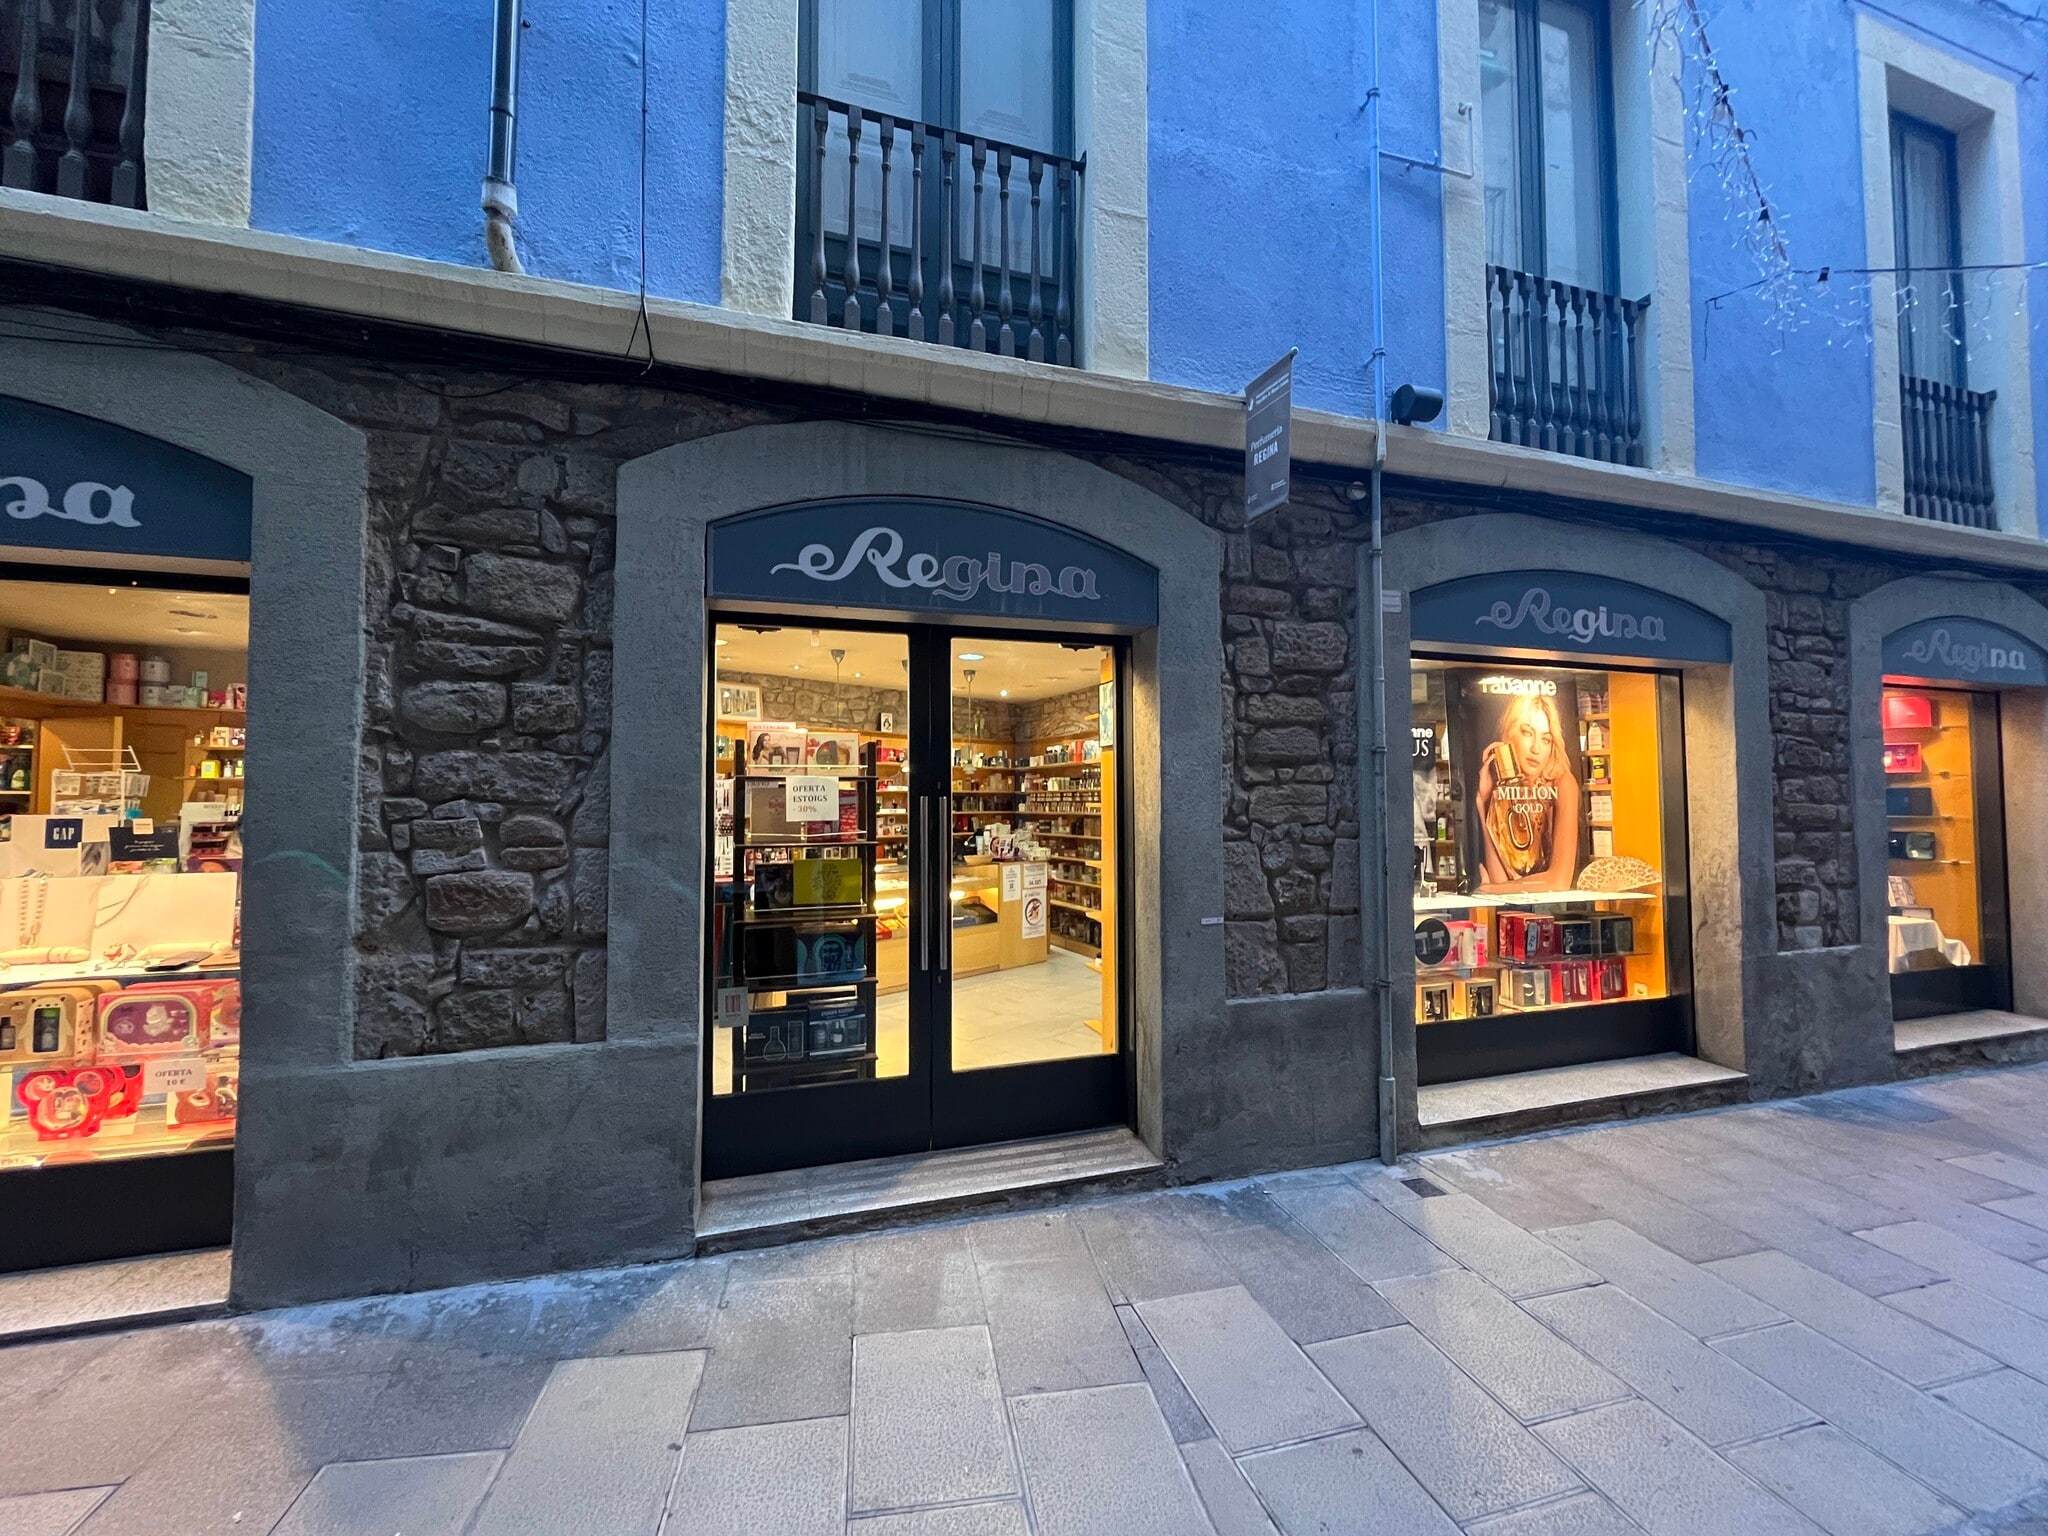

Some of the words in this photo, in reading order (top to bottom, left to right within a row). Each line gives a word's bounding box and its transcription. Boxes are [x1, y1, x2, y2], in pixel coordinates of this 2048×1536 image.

[1253, 440, 1279, 466] REGINA
[770, 526, 1101, 601] Regina
[1475, 587, 1667, 644] Regina
[1902, 629, 2026, 673] Regina
[1479, 676, 1558, 697] rabanne
[792, 784, 826, 793] OFERTA
[1497, 786, 1559, 800] MILLION
[793, 794, 828, 803] ESTOIGS
[1514, 803, 1544, 813] GOLD
[53, 827, 75, 840] GAP
[155, 1069, 193, 1078] OFERTA
